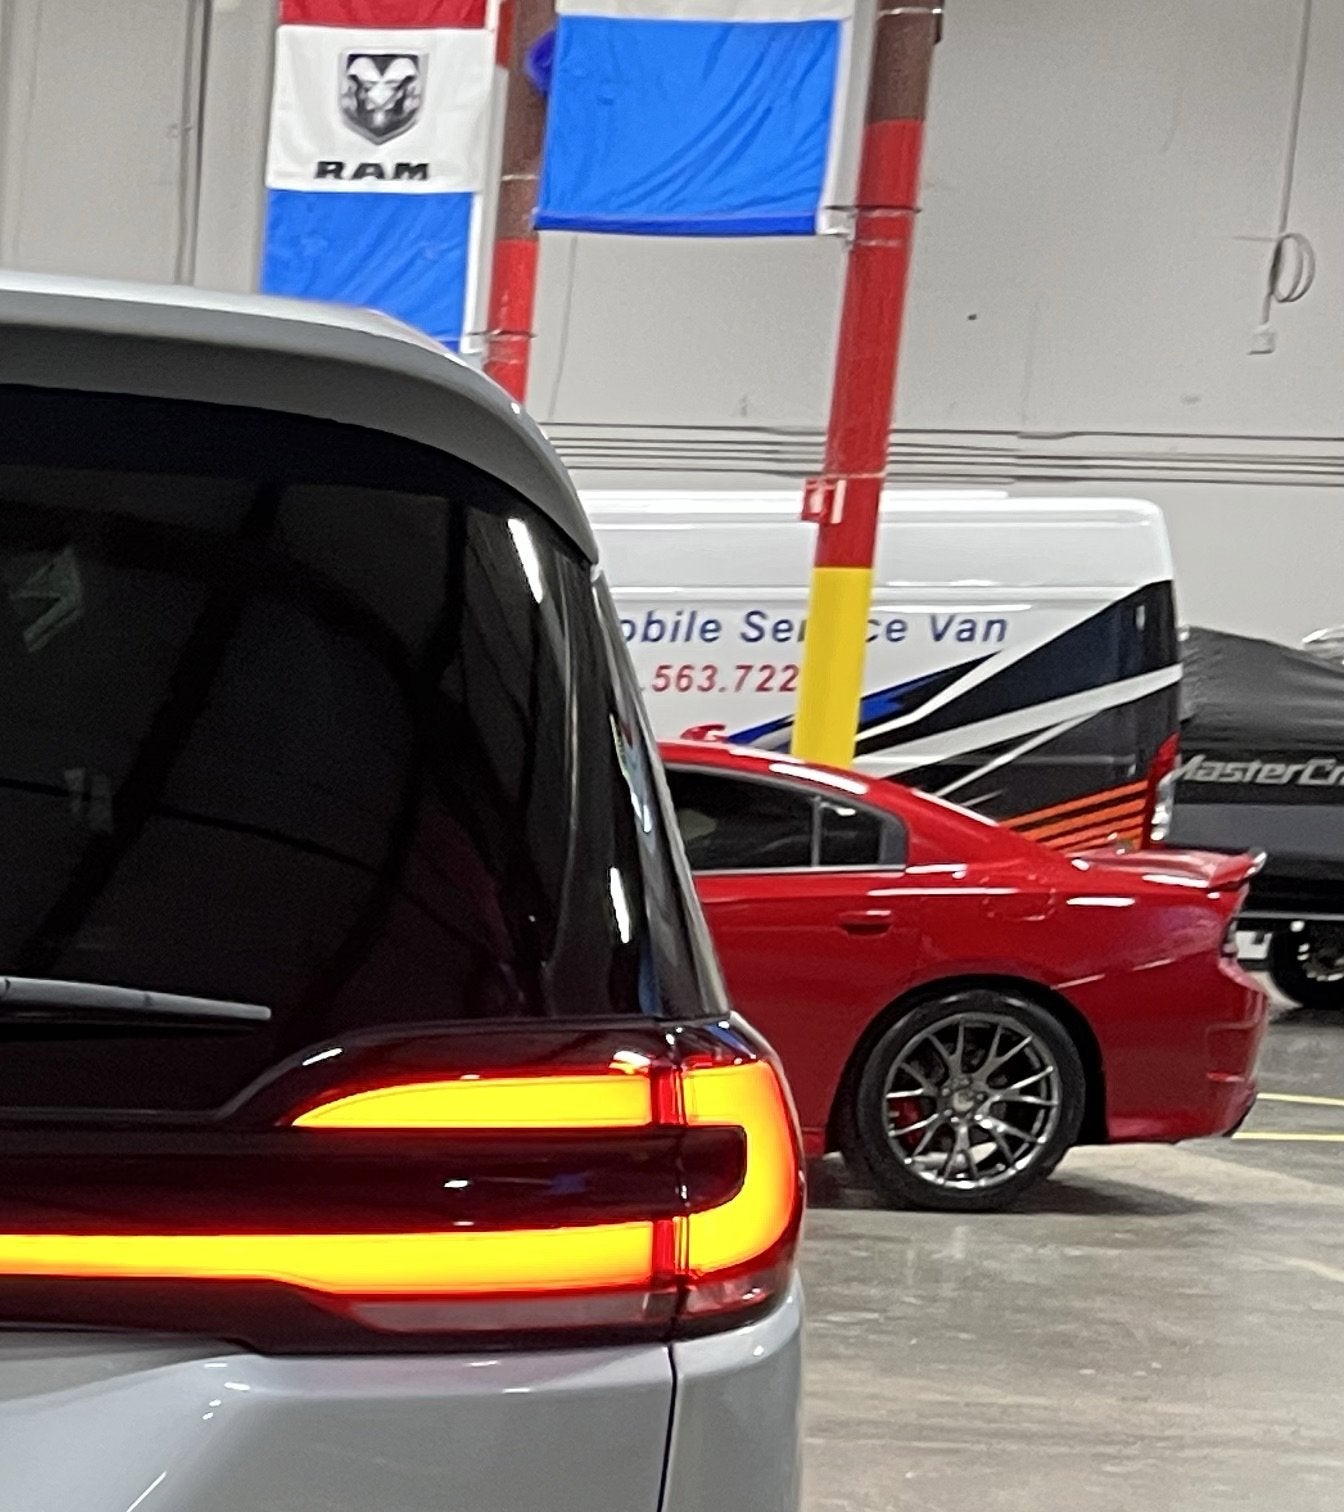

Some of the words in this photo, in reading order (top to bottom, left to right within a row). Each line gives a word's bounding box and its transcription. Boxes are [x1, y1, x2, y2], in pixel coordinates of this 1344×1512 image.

[314, 161, 429, 181] RAM
[620, 610, 722, 642] obile
[930, 613, 1008, 643] Van
